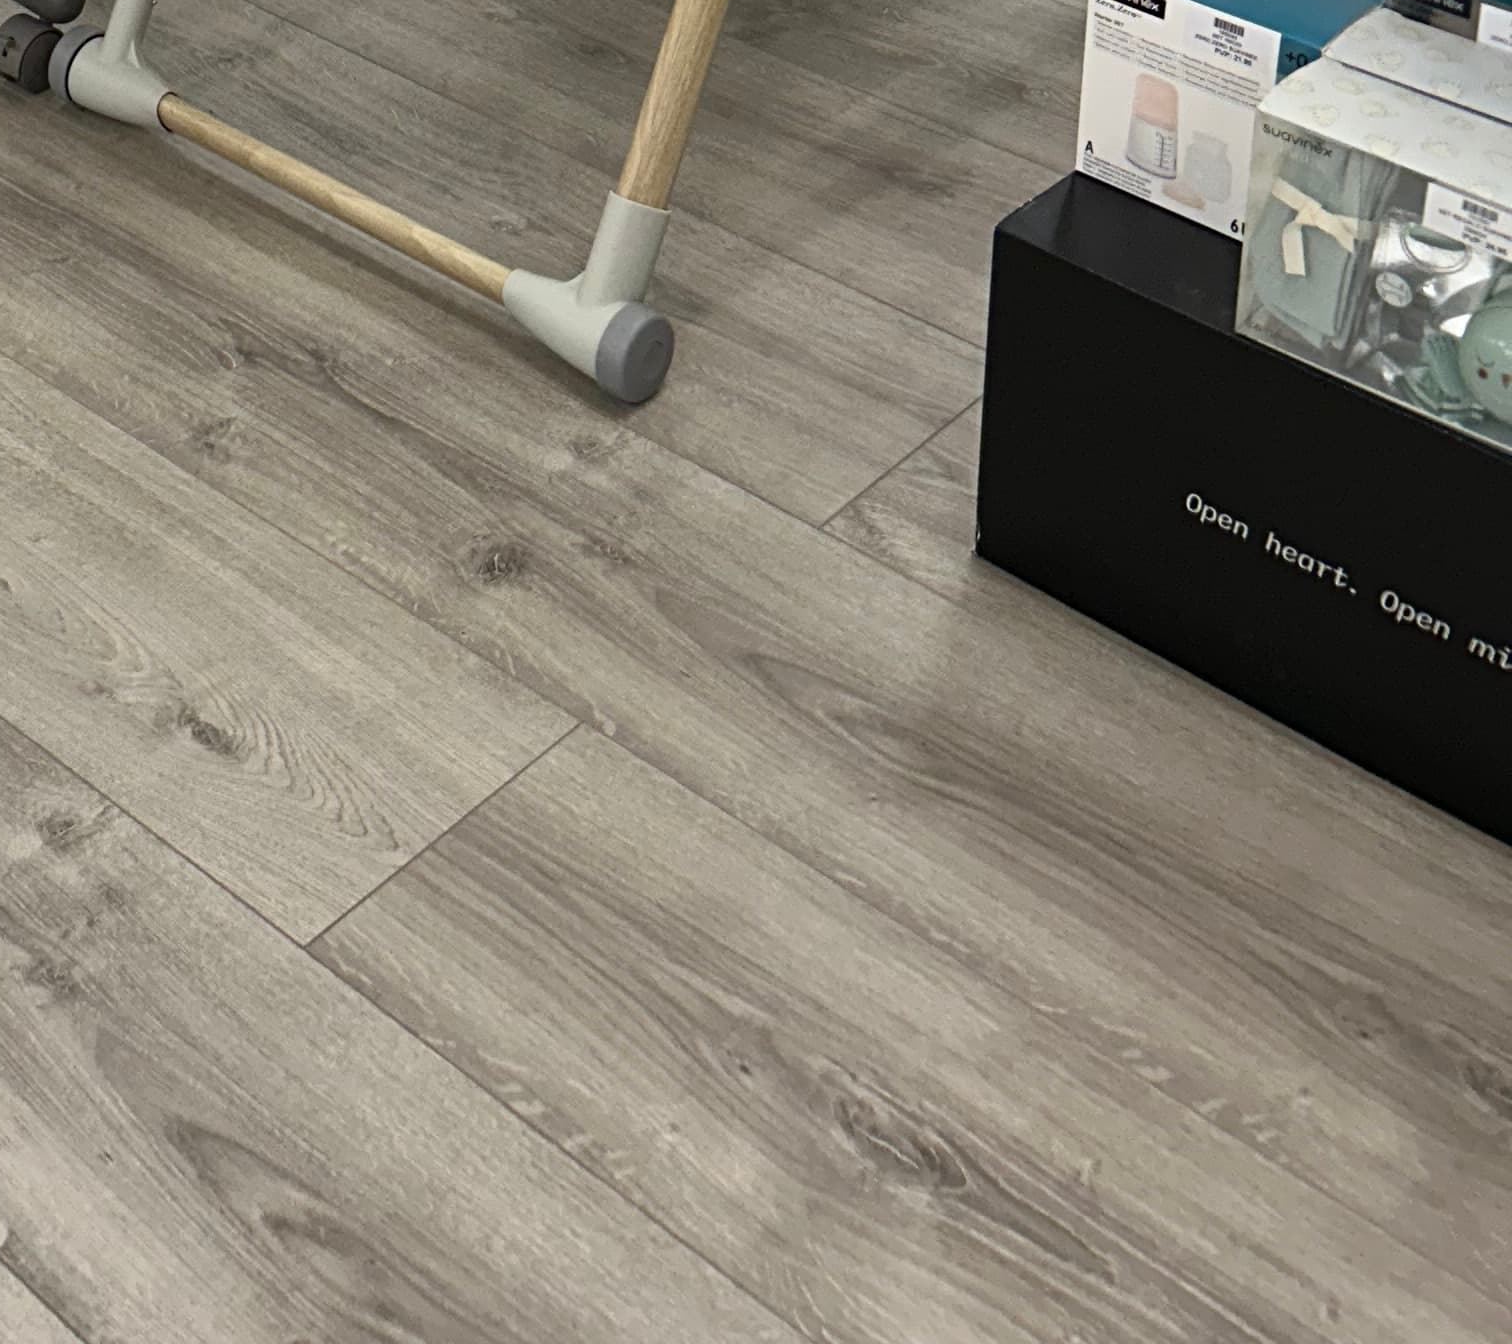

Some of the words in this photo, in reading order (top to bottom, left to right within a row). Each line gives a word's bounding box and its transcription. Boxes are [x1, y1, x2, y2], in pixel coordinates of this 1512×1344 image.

[1084, 140, 1094, 154] A
[1230, 218, 1239, 233] 6
[1185, 492, 1249, 540] Open
[1264, 530, 1357, 596] heart.
[1379, 588, 1452, 641] Open
